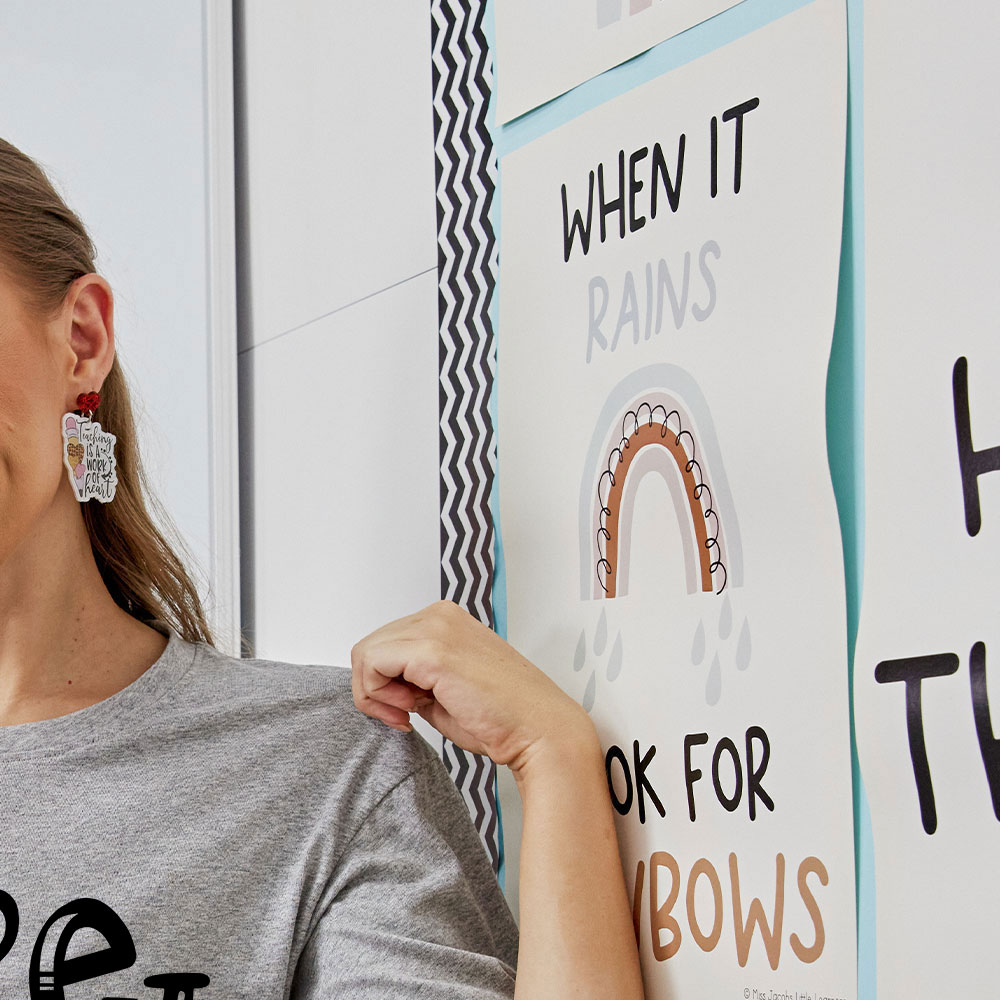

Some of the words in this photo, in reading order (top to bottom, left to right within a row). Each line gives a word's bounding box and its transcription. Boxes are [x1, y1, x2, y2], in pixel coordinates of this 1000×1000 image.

[561, 134, 685, 263] WHEN
[710, 97, 760, 199] IT
[585, 239, 722, 365] RAINS
[76, 418, 114, 454] Teaching
[86, 443, 94, 457] IS
[96, 444, 101, 458] A
[86, 458, 107, 472] WORK
[92, 472, 100, 484] OF
[85, 472, 114, 498] heart
[684, 725, 775, 823] FOR
[752, 988, 767, 1000] Miss
